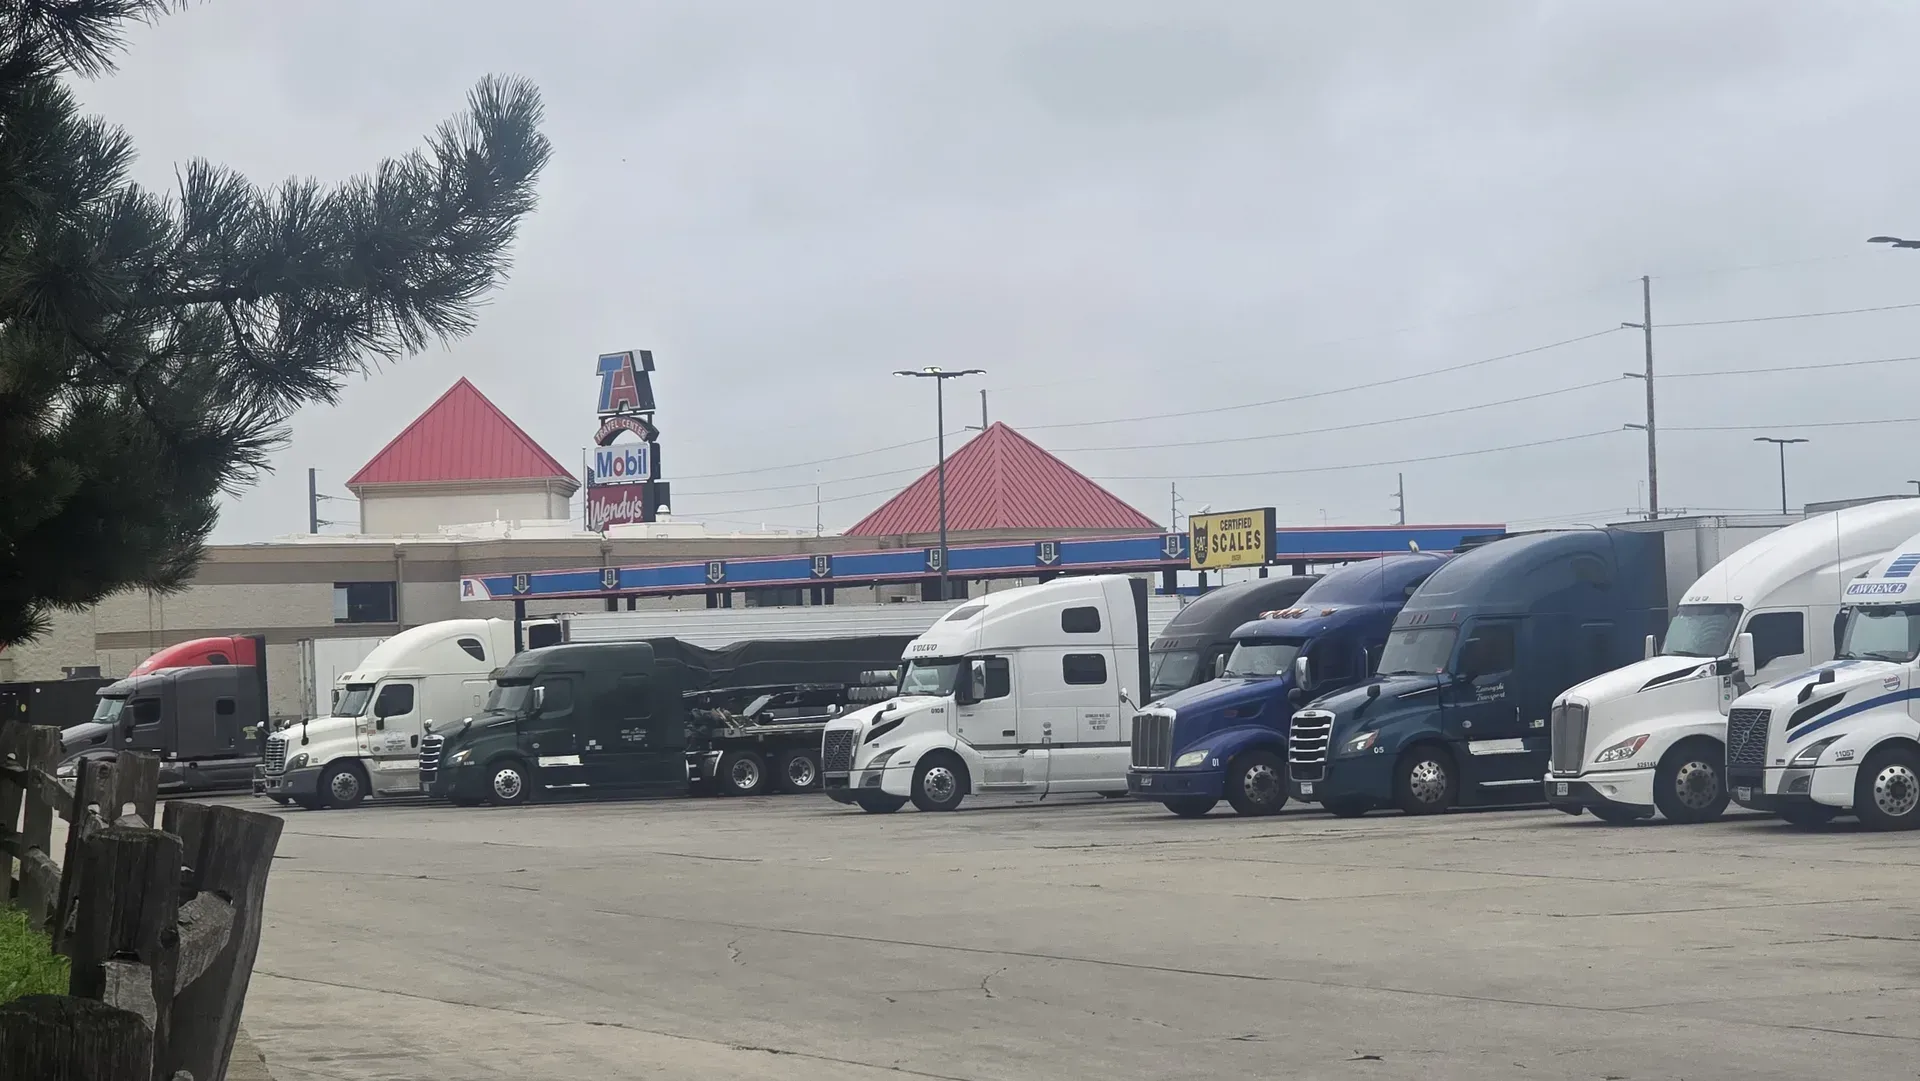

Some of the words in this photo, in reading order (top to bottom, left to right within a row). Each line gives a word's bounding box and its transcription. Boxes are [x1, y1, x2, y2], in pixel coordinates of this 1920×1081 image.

[597, 350, 641, 413] TA
[596, 419, 619, 441] TRAVEL
[621, 418, 648, 441] CENTER
[597, 448, 647, 478] Mobil
[590, 490, 643, 531] Wendy's
[1220, 517, 1252, 532] CERTIFIED
[1212, 529, 1261, 553] SCALES
[1848, 583, 1905, 594] LAWRENCE
[912, 643, 938, 652] VOLVO
[1373, 746, 1385, 754] 05
[1212, 758, 1220, 767] 01
